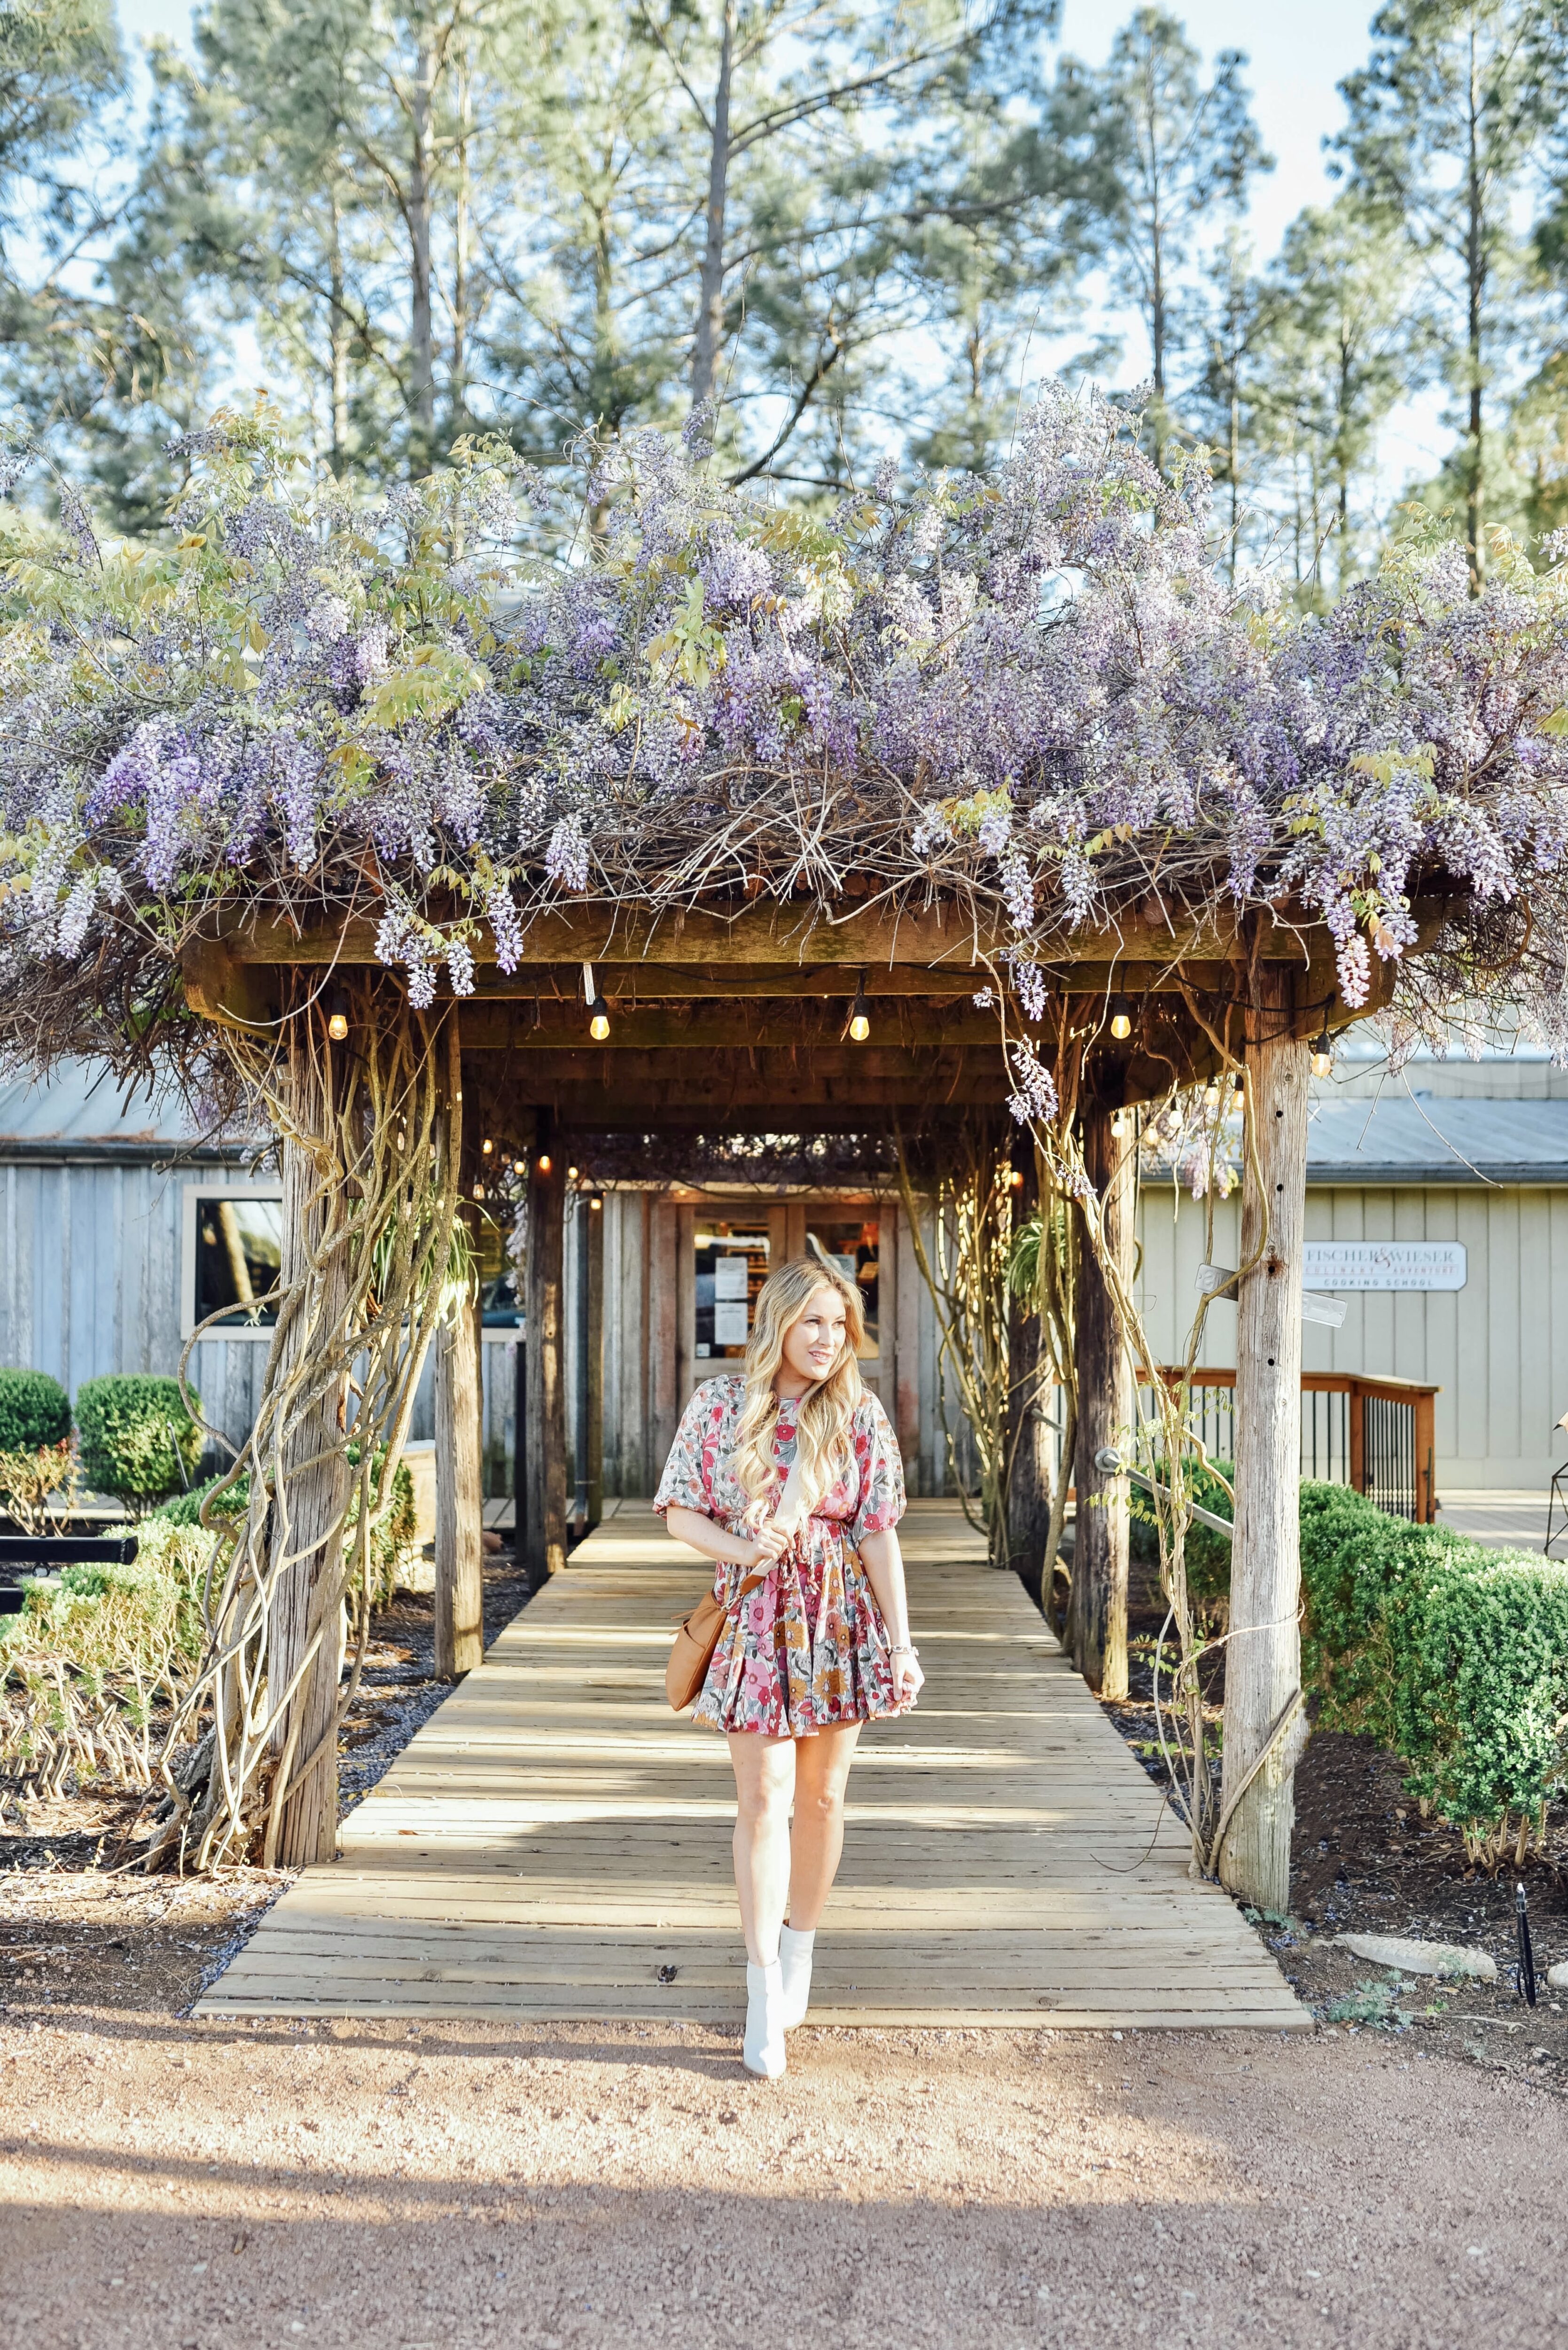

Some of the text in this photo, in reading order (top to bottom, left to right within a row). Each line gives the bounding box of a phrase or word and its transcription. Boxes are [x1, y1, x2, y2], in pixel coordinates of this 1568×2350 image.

[1389, 1249, 1453, 1262] WIESER
[1306, 1266, 1453, 1275] CULINARY ADVENTURE
